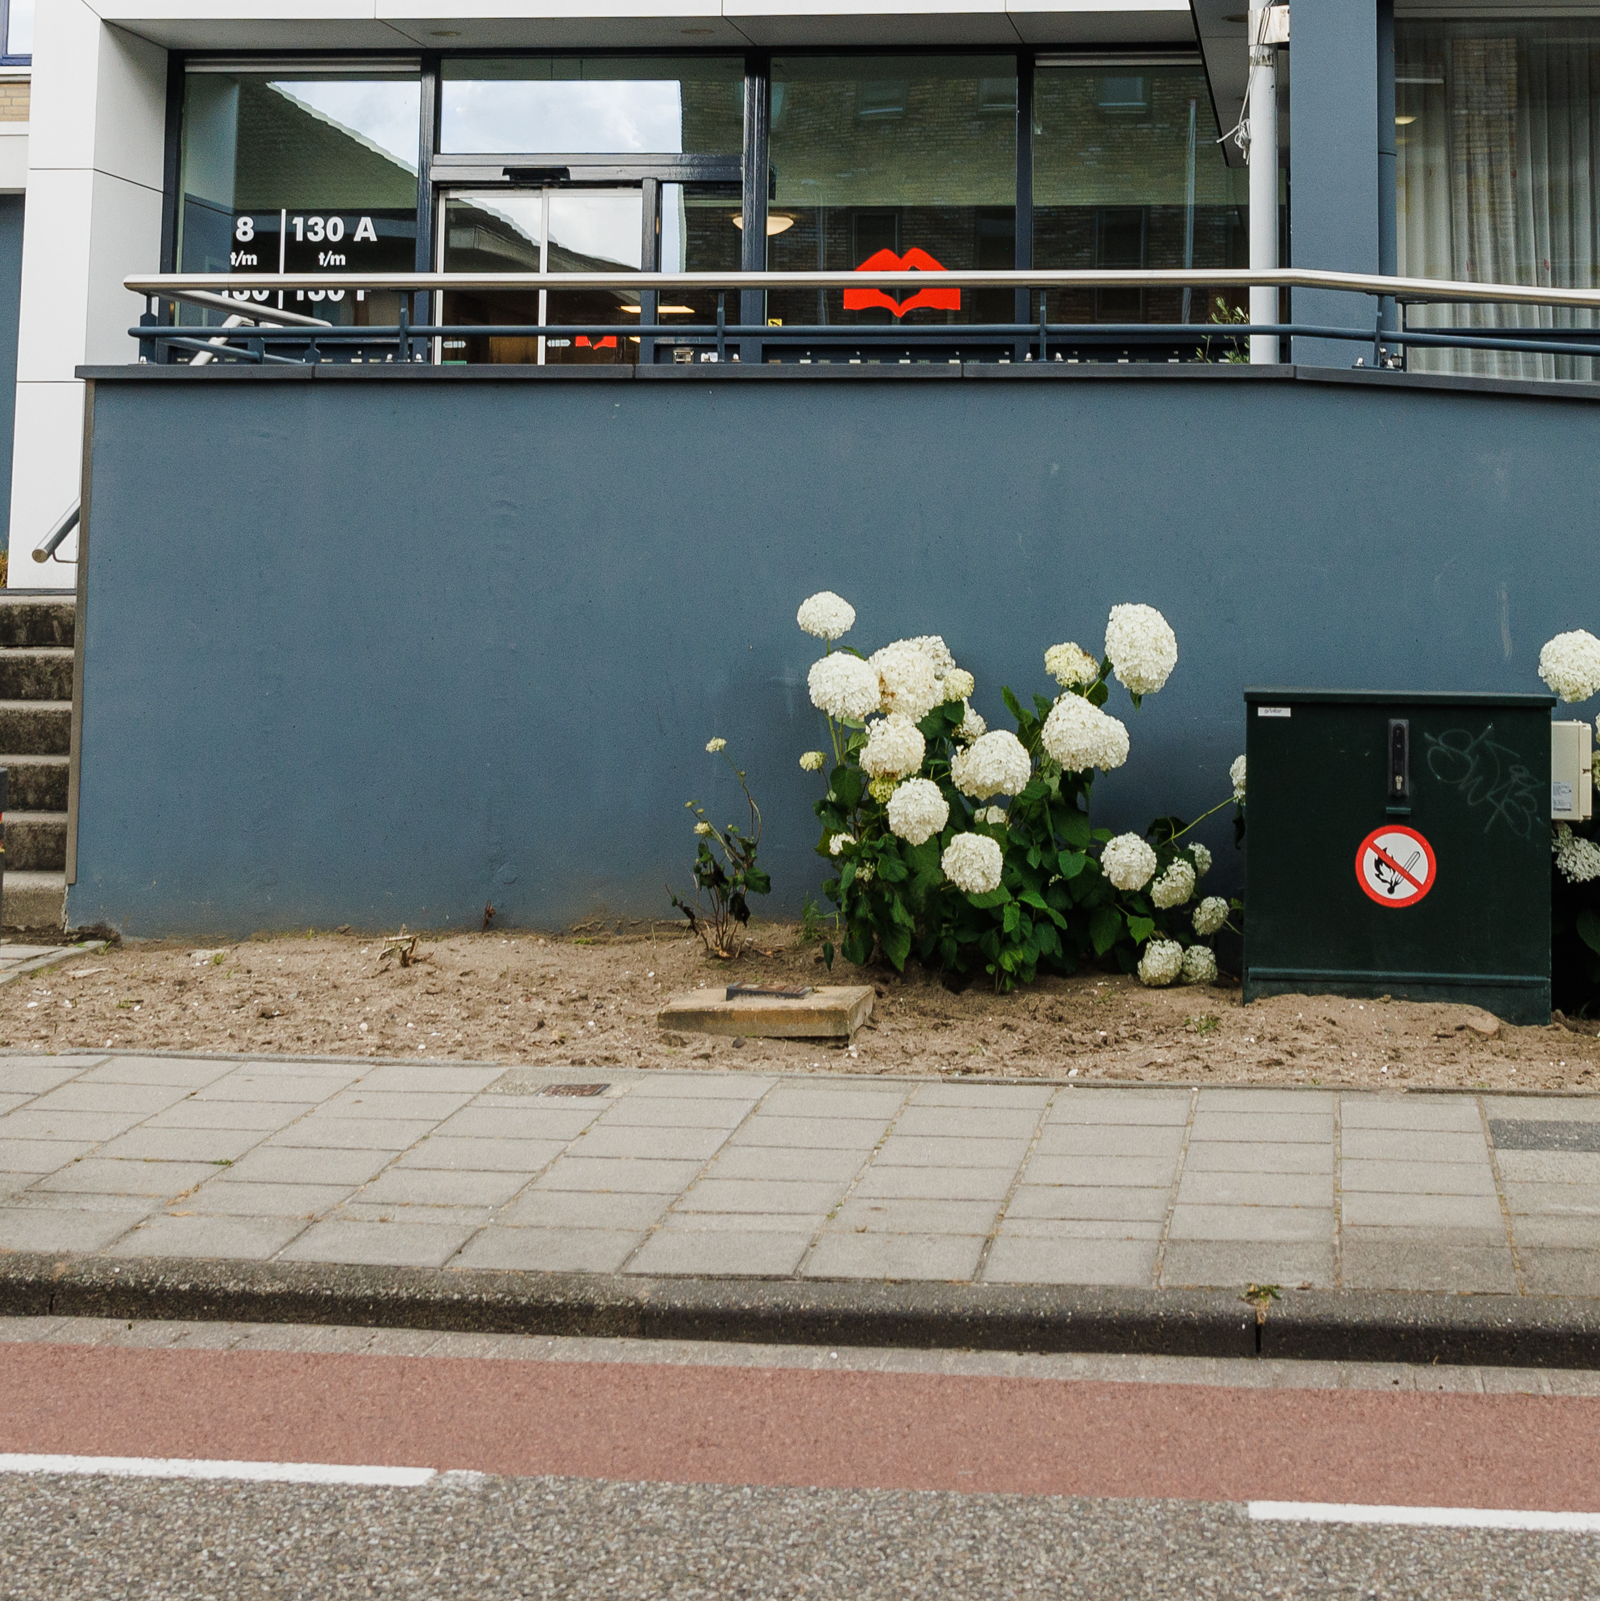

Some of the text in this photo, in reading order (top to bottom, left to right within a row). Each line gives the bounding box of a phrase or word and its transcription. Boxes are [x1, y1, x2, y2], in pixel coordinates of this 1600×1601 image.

[235, 216, 255, 242] 8
[292, 216, 378, 242] 130 A
[230, 250, 258, 267] t/m
[318, 250, 346, 267] t/m
